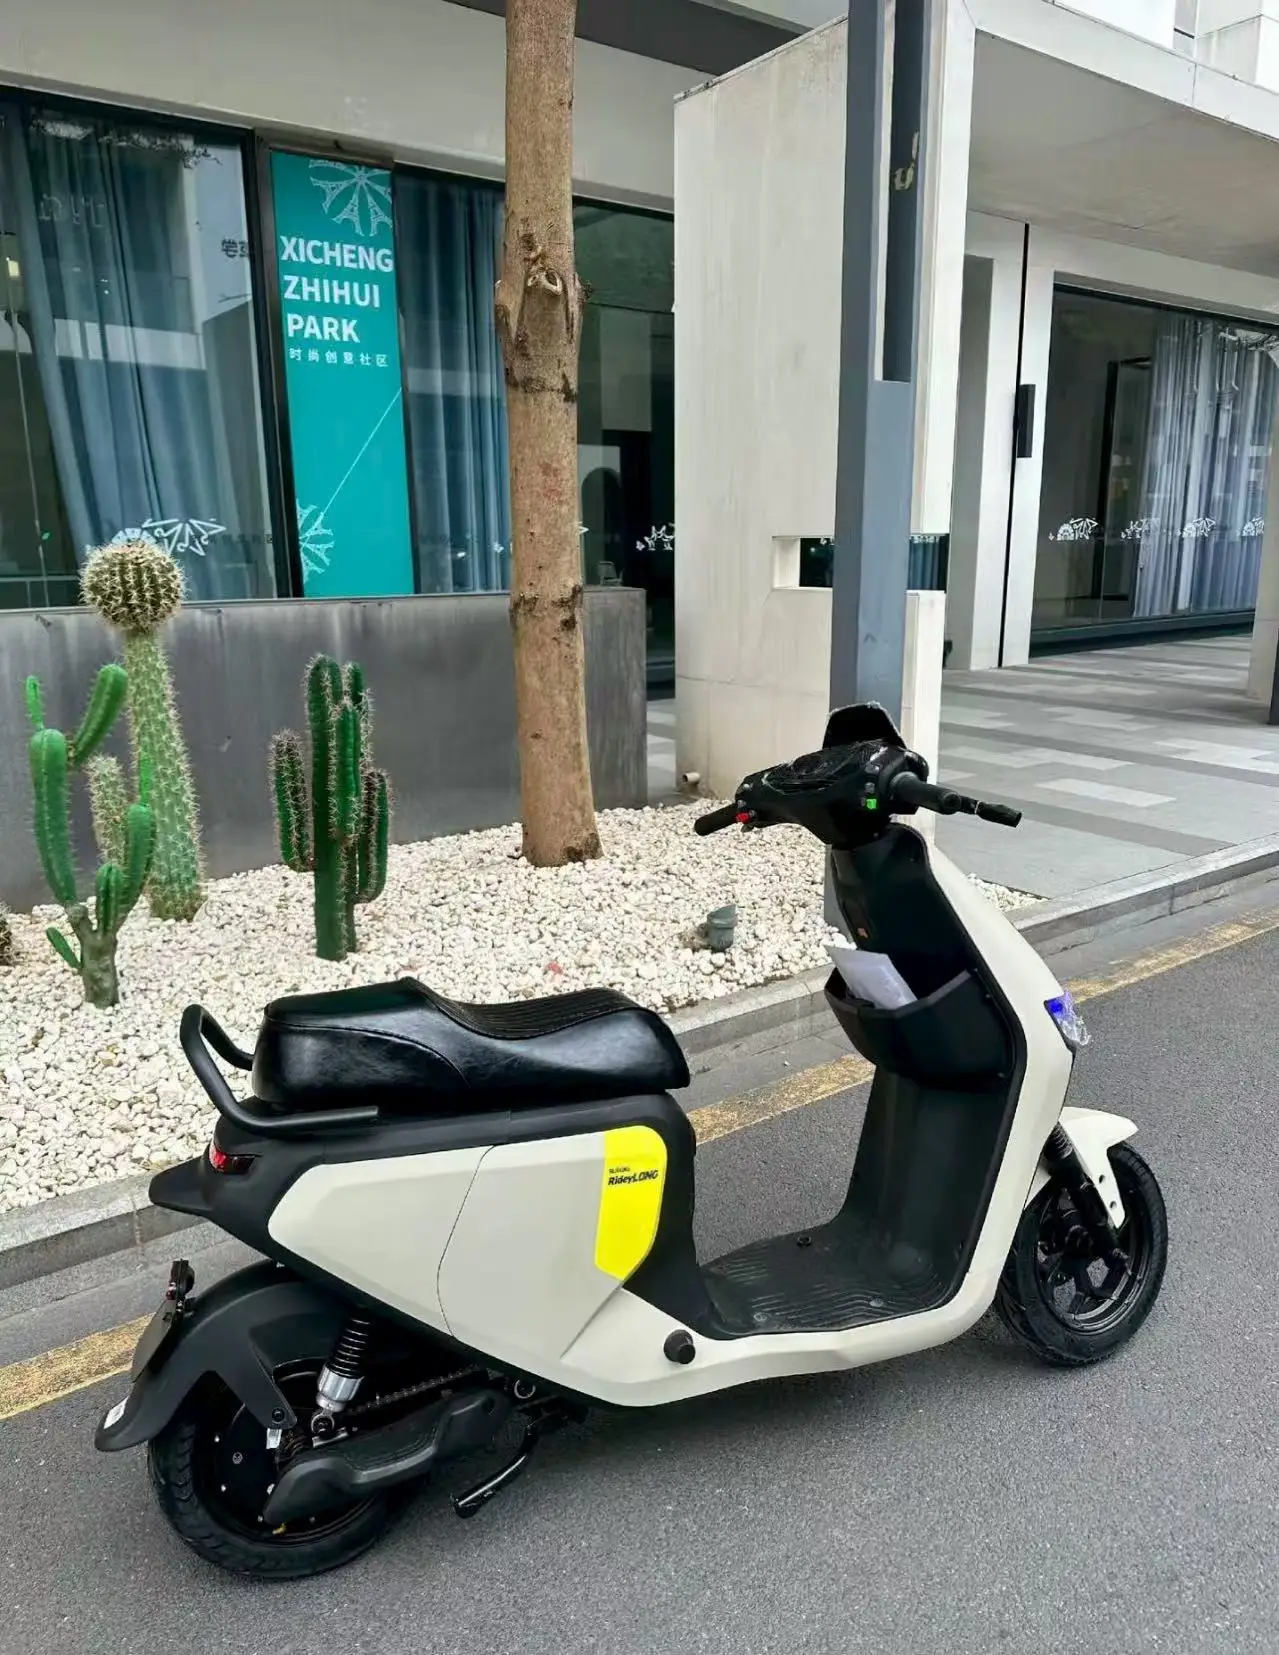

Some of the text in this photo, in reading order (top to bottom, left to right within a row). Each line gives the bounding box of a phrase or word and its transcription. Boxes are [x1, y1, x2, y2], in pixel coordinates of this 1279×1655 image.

[280, 235, 394, 272] XICHENG
[283, 275, 380, 308] ZHIHUI
[287, 313, 361, 343] PARK
[289, 347, 389, 367] 时尚创意社区
